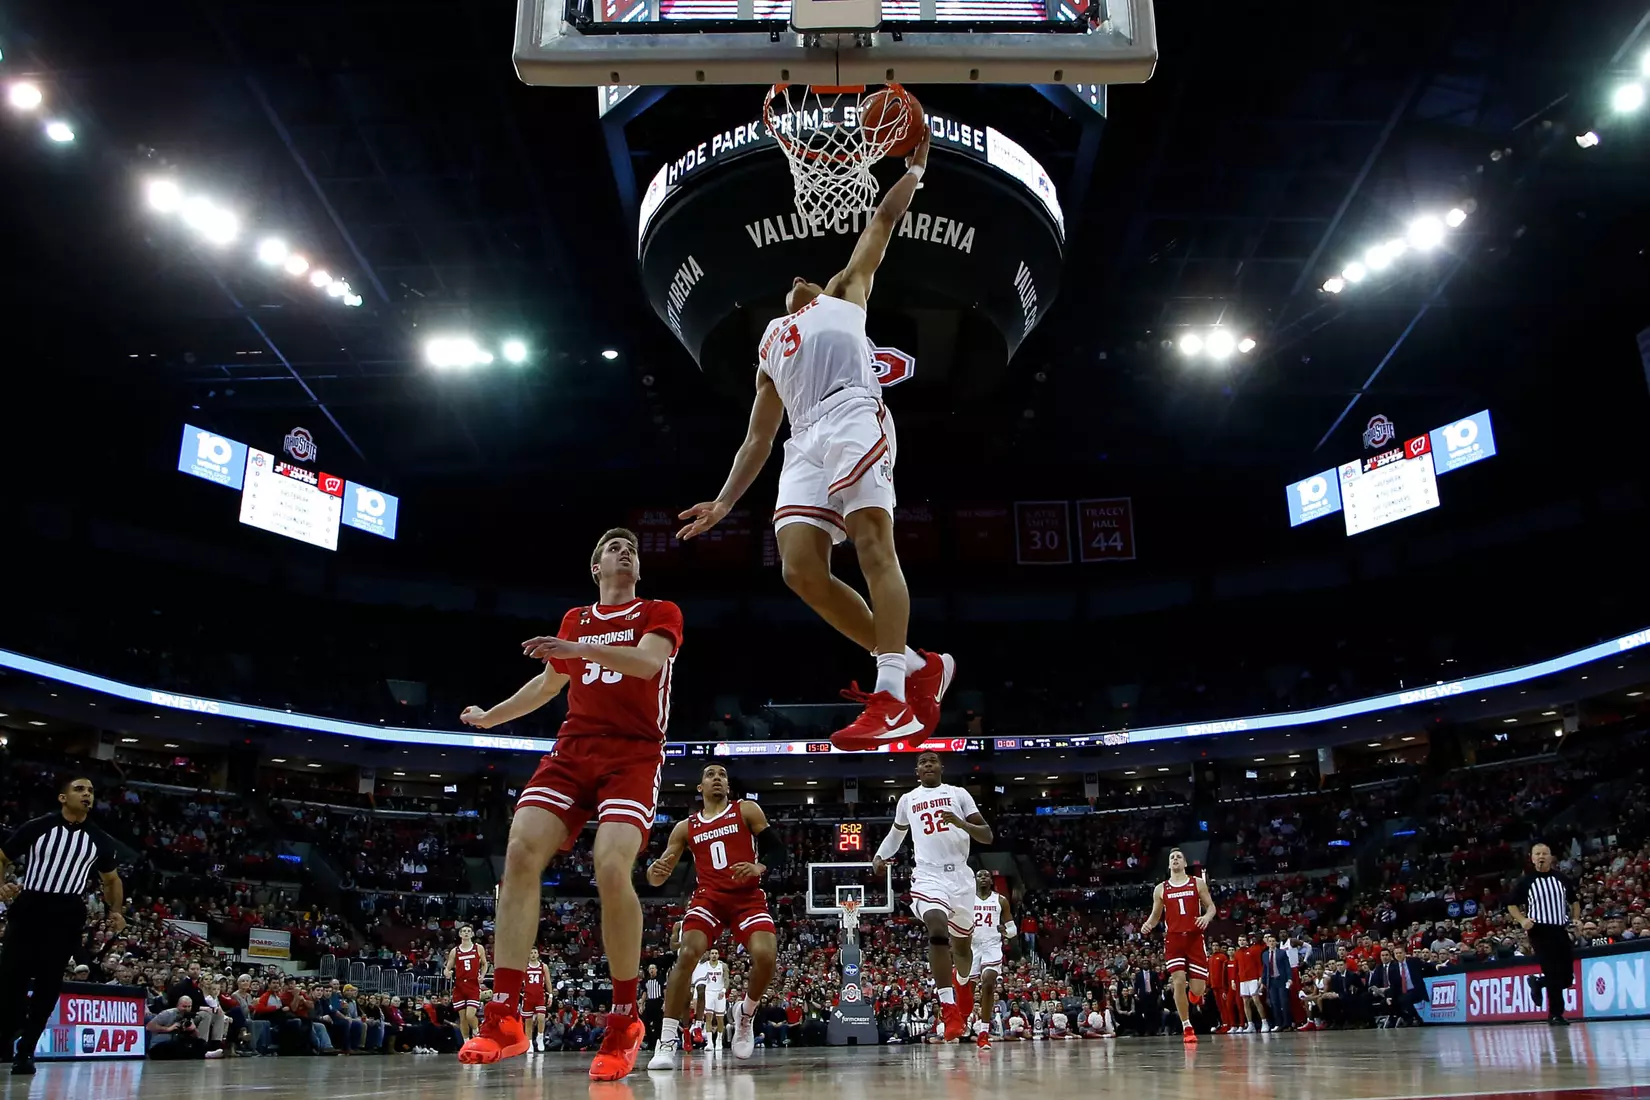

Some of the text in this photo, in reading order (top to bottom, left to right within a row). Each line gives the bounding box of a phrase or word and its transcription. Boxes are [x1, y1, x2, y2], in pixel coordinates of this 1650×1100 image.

[669, 142, 706, 185] HYDE
[712, 120, 760, 157] PARK
[766, 107, 834, 137] PRIME
[746, 206, 976, 254] VALUE CIT ARENA
[668, 255, 704, 314] ARENA
[1014, 260, 1037, 317] VALUE
[760, 327, 780, 360] OHIO
[780, 323, 801, 358] 3
[1442, 419, 1478, 452] 10
[196, 432, 232, 465] 10
[1297, 476, 1327, 506] 10
[356, 488, 386, 517] 10
[1085, 507, 1126, 518] TRACEY
[1092, 519, 1120, 528] HALL
[1029, 530, 1060, 550] 30
[1091, 531, 1124, 552] 44
[578, 628, 634, 645] WISCONSIN
[774, 744, 781, 752] 7
[808, 744, 829, 752] 15:02
[912, 797, 952, 814] OHIO STATE
[841, 823, 862, 834] 15:02
[920, 809, 950, 836] 32
[693, 824, 738, 844] WISCONSIN
[840, 834, 860, 851] 29
[710, 841, 728, 870] 0
[1178, 898, 1186, 915] 1
[975, 912, 993, 927] 24
[464, 960, 471, 971] 5
[529, 975, 540, 983] 34
[712, 975, 717, 983] 4
[1432, 985, 1455, 1004] BTN
[67, 998, 137, 1024] STREAMING
[53, 1028, 69, 1052] THE
[96, 1029, 138, 1052] APP
[83, 1033, 95, 1041] FOX
